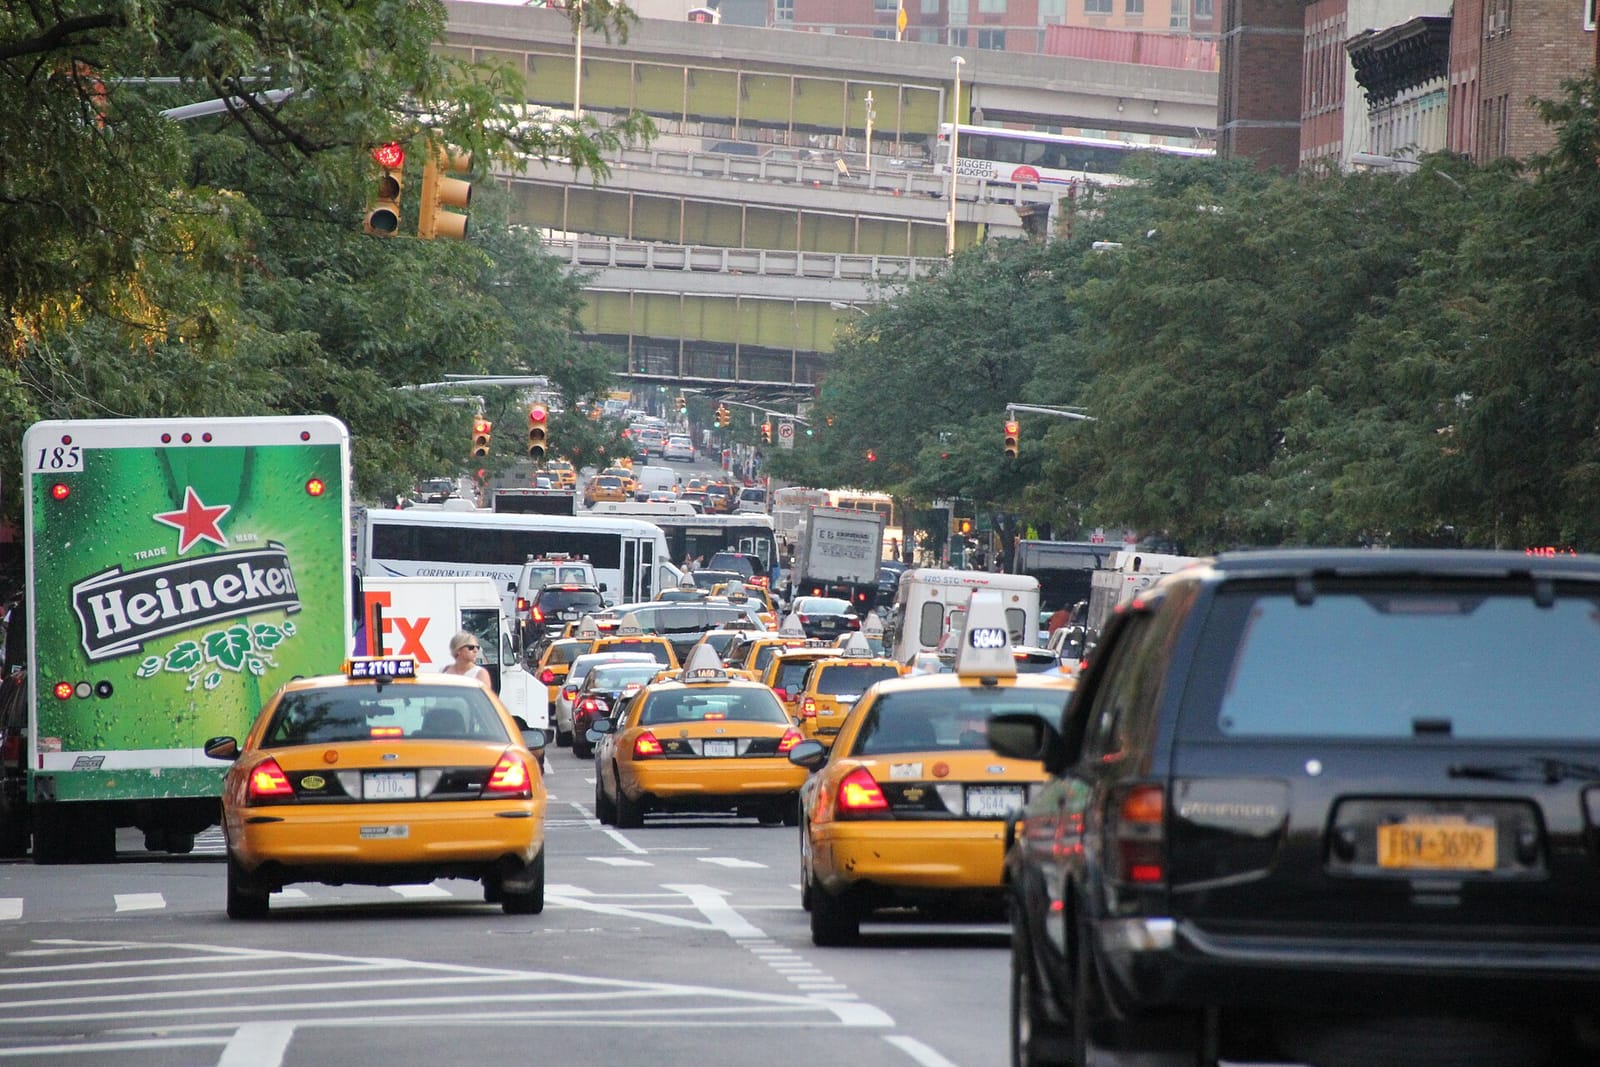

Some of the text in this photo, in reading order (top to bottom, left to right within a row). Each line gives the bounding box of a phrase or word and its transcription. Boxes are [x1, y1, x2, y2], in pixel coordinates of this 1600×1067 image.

[956, 159, 993, 170] BIGGER
[956, 168, 993, 177] JACKPOT
[36, 446, 80, 470] 185
[133, 533, 258, 560] TRADE MARK
[416, 568, 472, 577] CORPORATE
[88, 560, 296, 639] Heineken
[973, 628, 1004, 648] 5G44
[368, 660, 396, 675] 2T10
